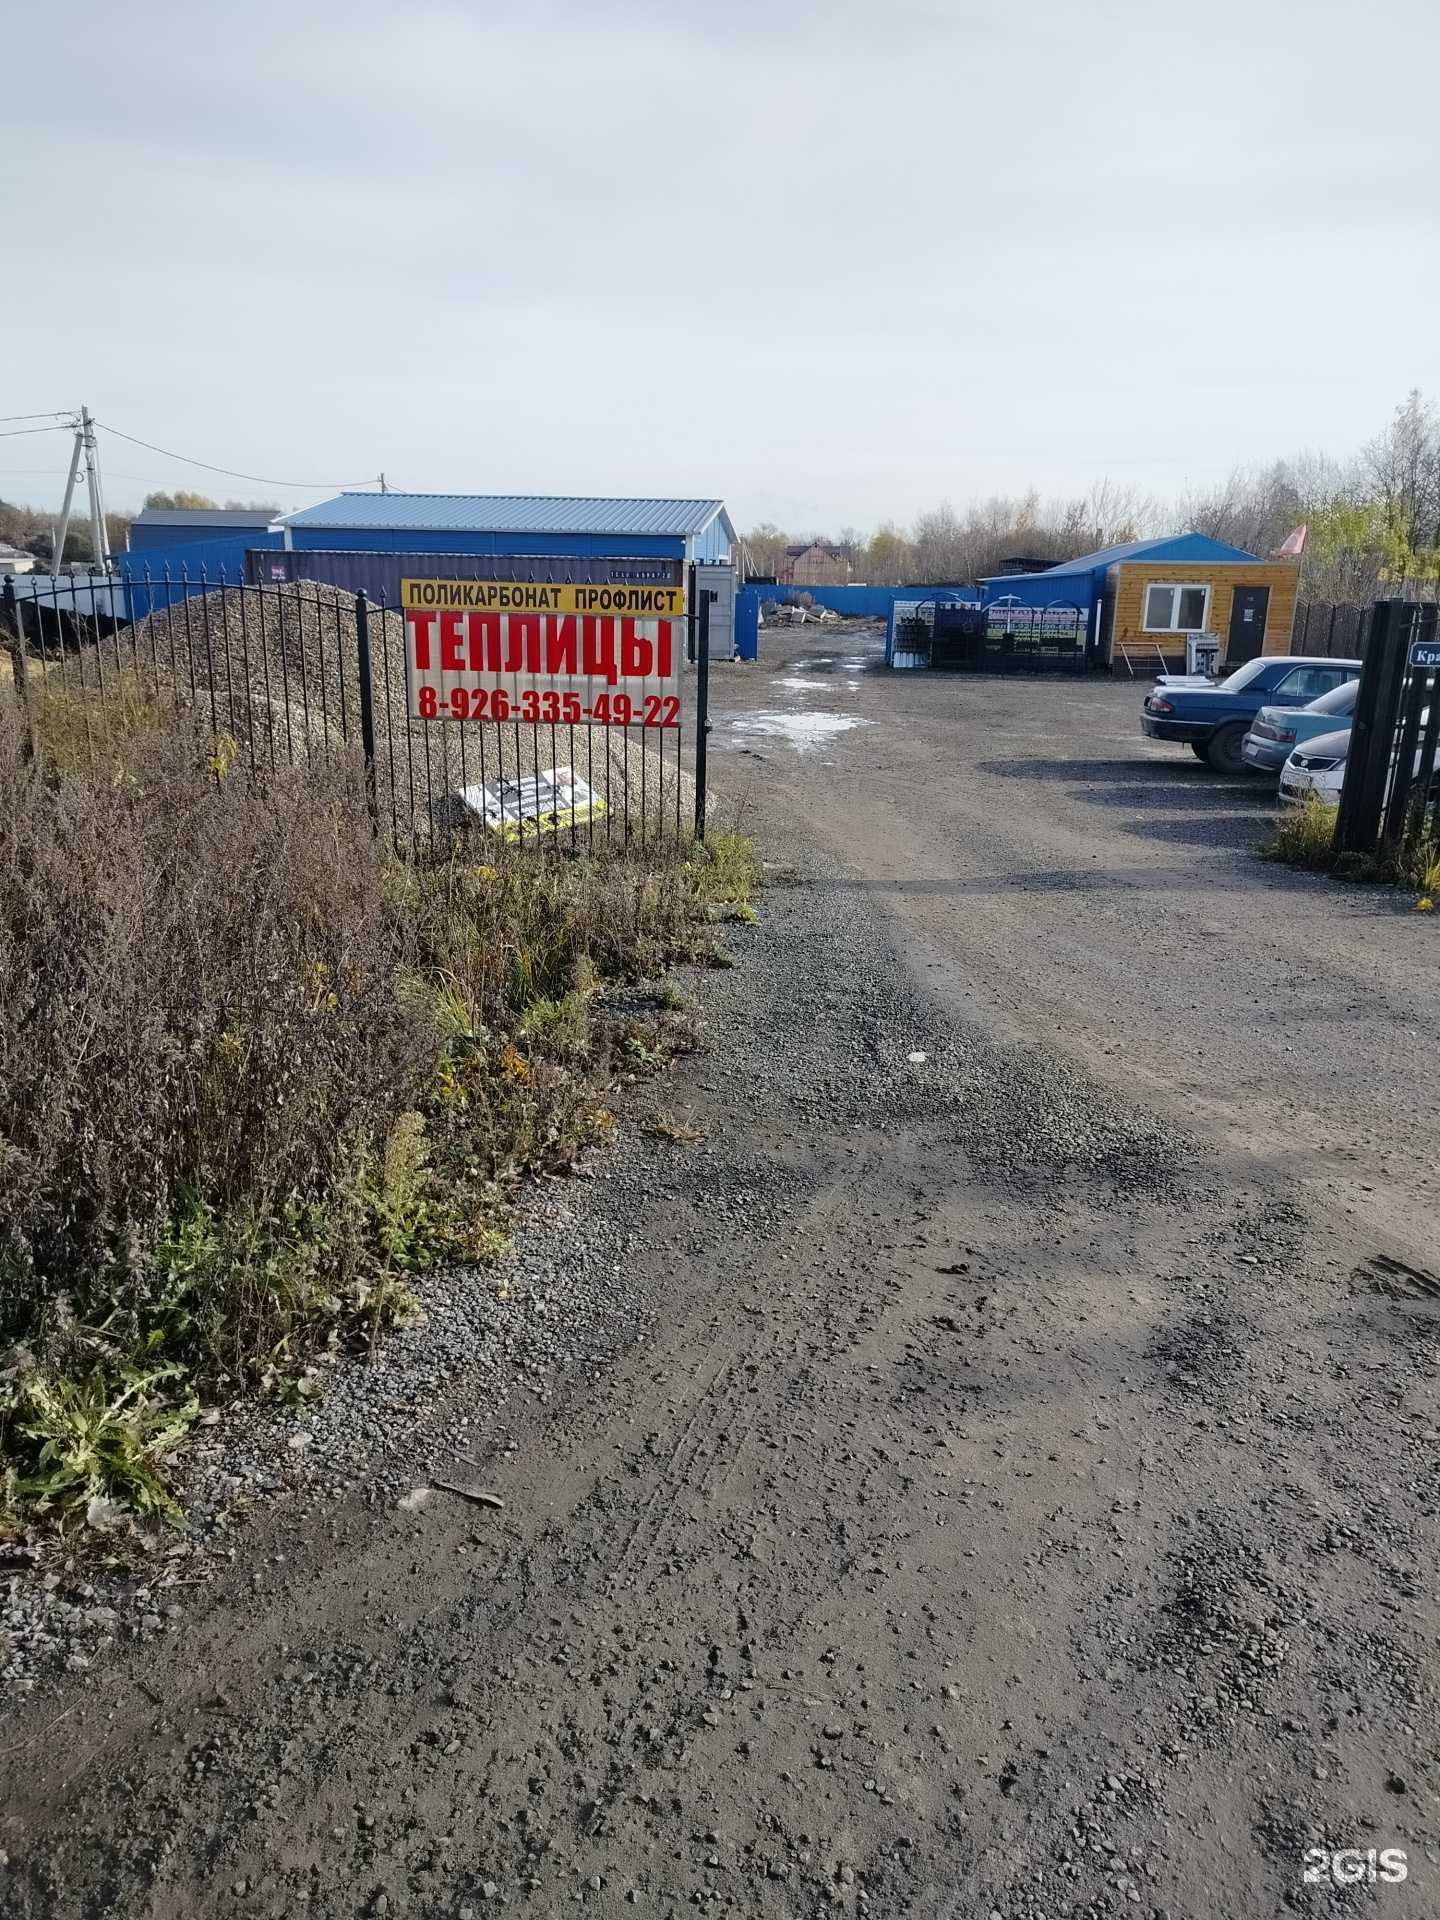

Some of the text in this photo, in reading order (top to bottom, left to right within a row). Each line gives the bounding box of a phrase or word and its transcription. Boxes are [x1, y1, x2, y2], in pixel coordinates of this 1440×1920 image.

[410, 583, 677, 611] ПОЛИКАРБОНАТ ПРОФЛИСТ
[406, 610, 672, 685] ТЕПЛИЦЫ
[419, 686, 681, 728] 8-926-335-49-22
